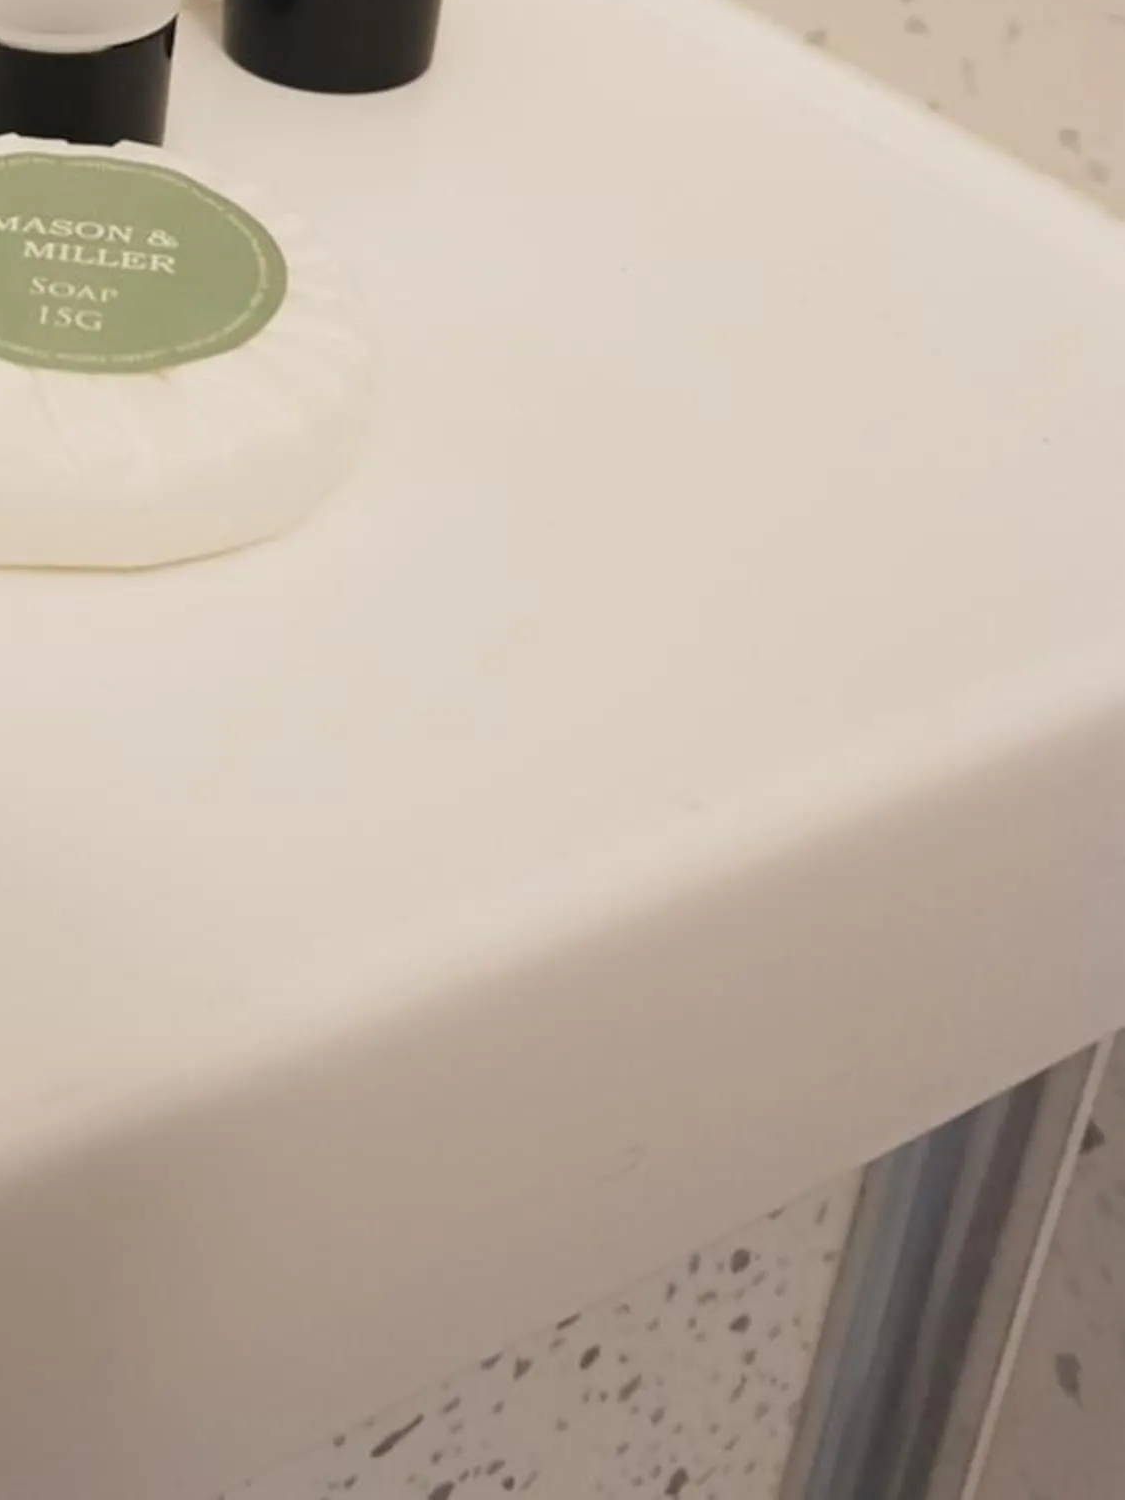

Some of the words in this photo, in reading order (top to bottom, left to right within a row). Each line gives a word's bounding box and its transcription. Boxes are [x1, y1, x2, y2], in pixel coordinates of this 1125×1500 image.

[146, 229, 180, 248] &
[22, 241, 176, 274] MILLER
[28, 276, 119, 304] SOAP
[37, 306, 105, 332] 15G
